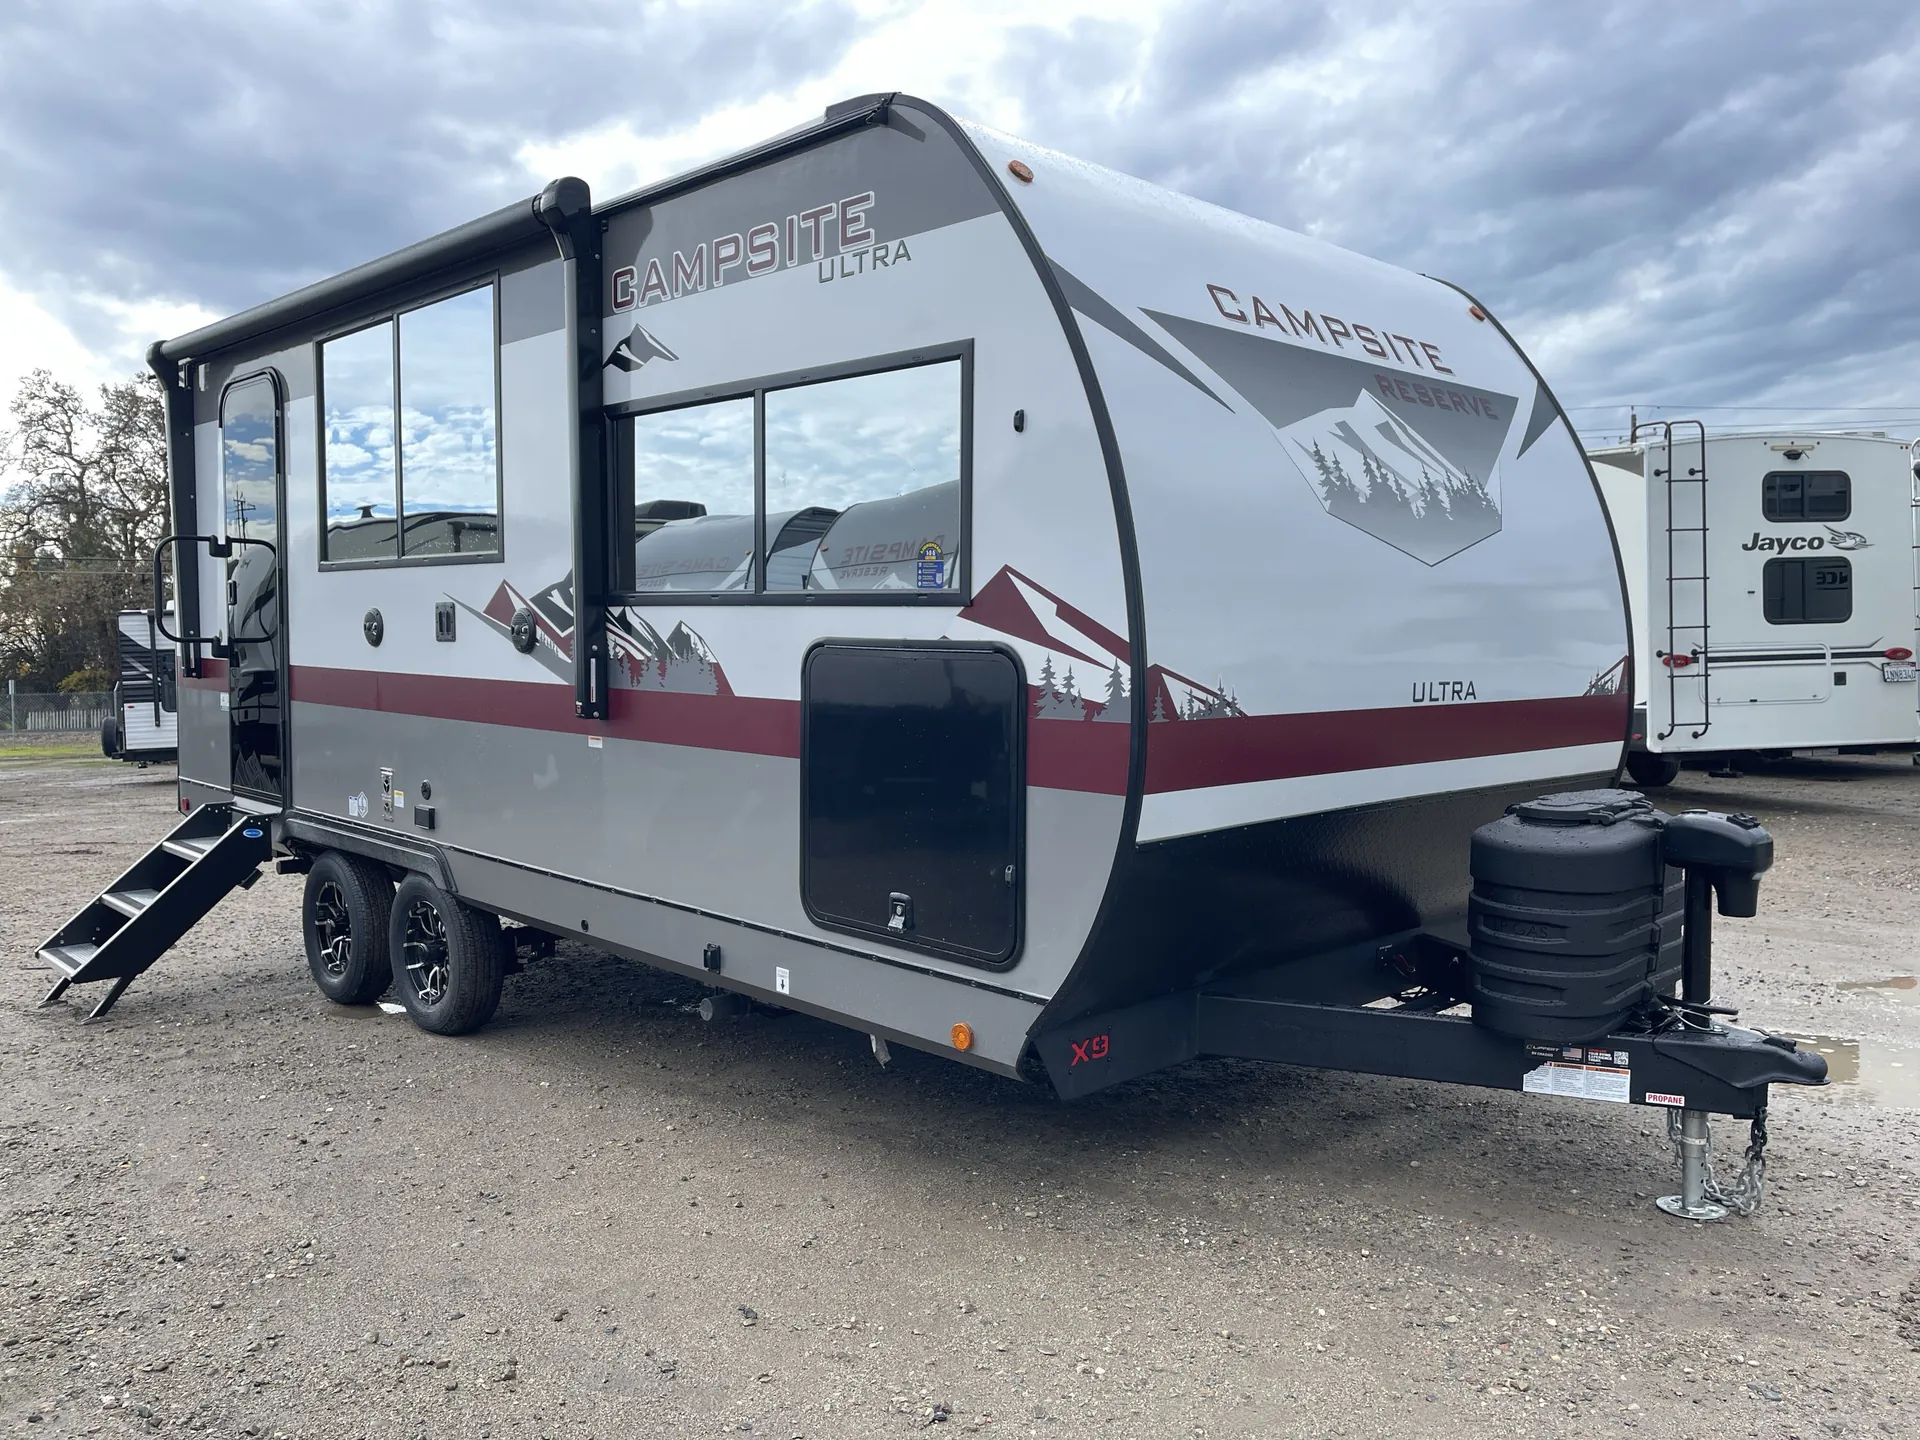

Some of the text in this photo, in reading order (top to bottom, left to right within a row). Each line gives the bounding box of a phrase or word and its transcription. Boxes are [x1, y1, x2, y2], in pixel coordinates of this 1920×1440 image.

[611, 190, 875, 313] CAMPSITE
[818, 239, 911, 283] ULTRA
[1206, 283, 1454, 376] CAMPSITE
[1374, 373, 1500, 421] RESERVE
[1742, 532, 1824, 555] Jayco
[1412, 680, 1477, 703] ULTRA
[1513, 922, 1549, 939] GAS
[1647, 1093, 1683, 1105] PROPANE
